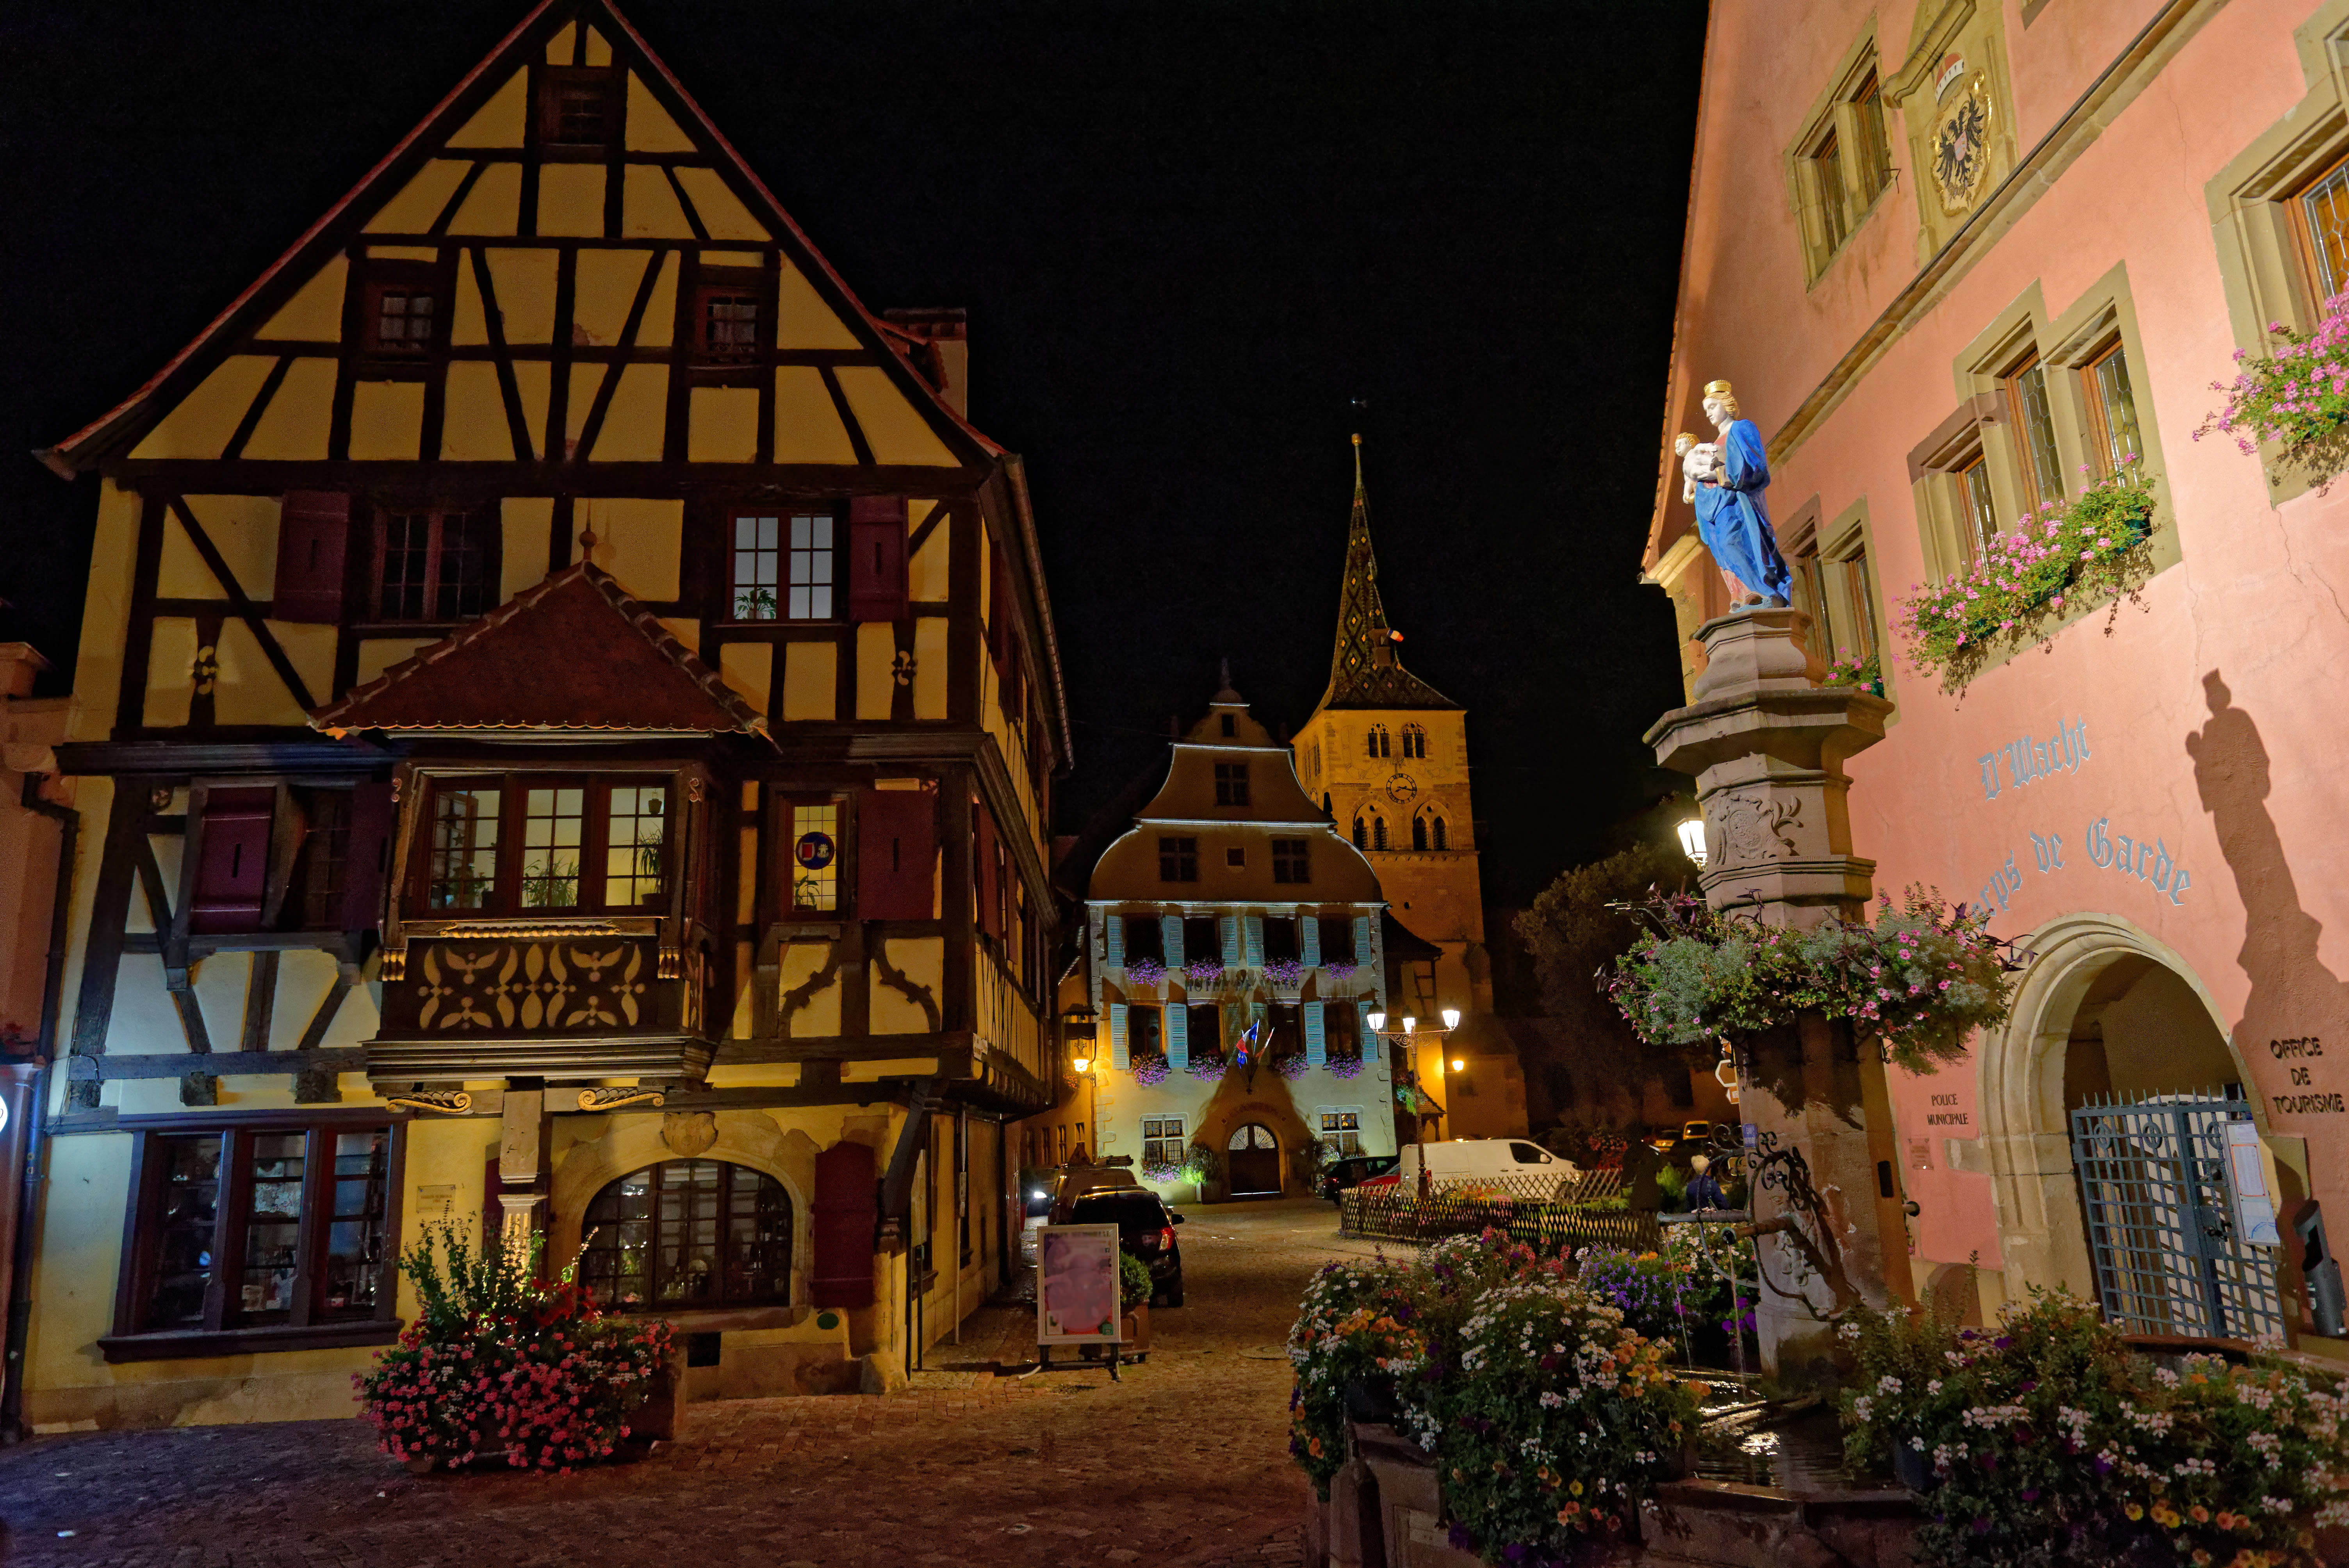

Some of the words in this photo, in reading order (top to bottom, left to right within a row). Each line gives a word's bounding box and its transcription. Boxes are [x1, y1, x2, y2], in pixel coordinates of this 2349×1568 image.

[1977, 714, 2091, 802] D'Wacht
[1969, 850, 2023, 933] orps
[2030, 830, 2065, 874] de
[2085, 816, 2191, 906] Garde
[1235, 980, 1252, 991] DE
[2270, 1037, 2323, 1059] OFFICE
[2290, 1067, 2311, 1086] DE
[1931, 1094, 1958, 1106] POLICE
[2272, 1093, 2345, 1114] TOURISME
[1927, 1113, 1968, 1126] MUNICIPALE
